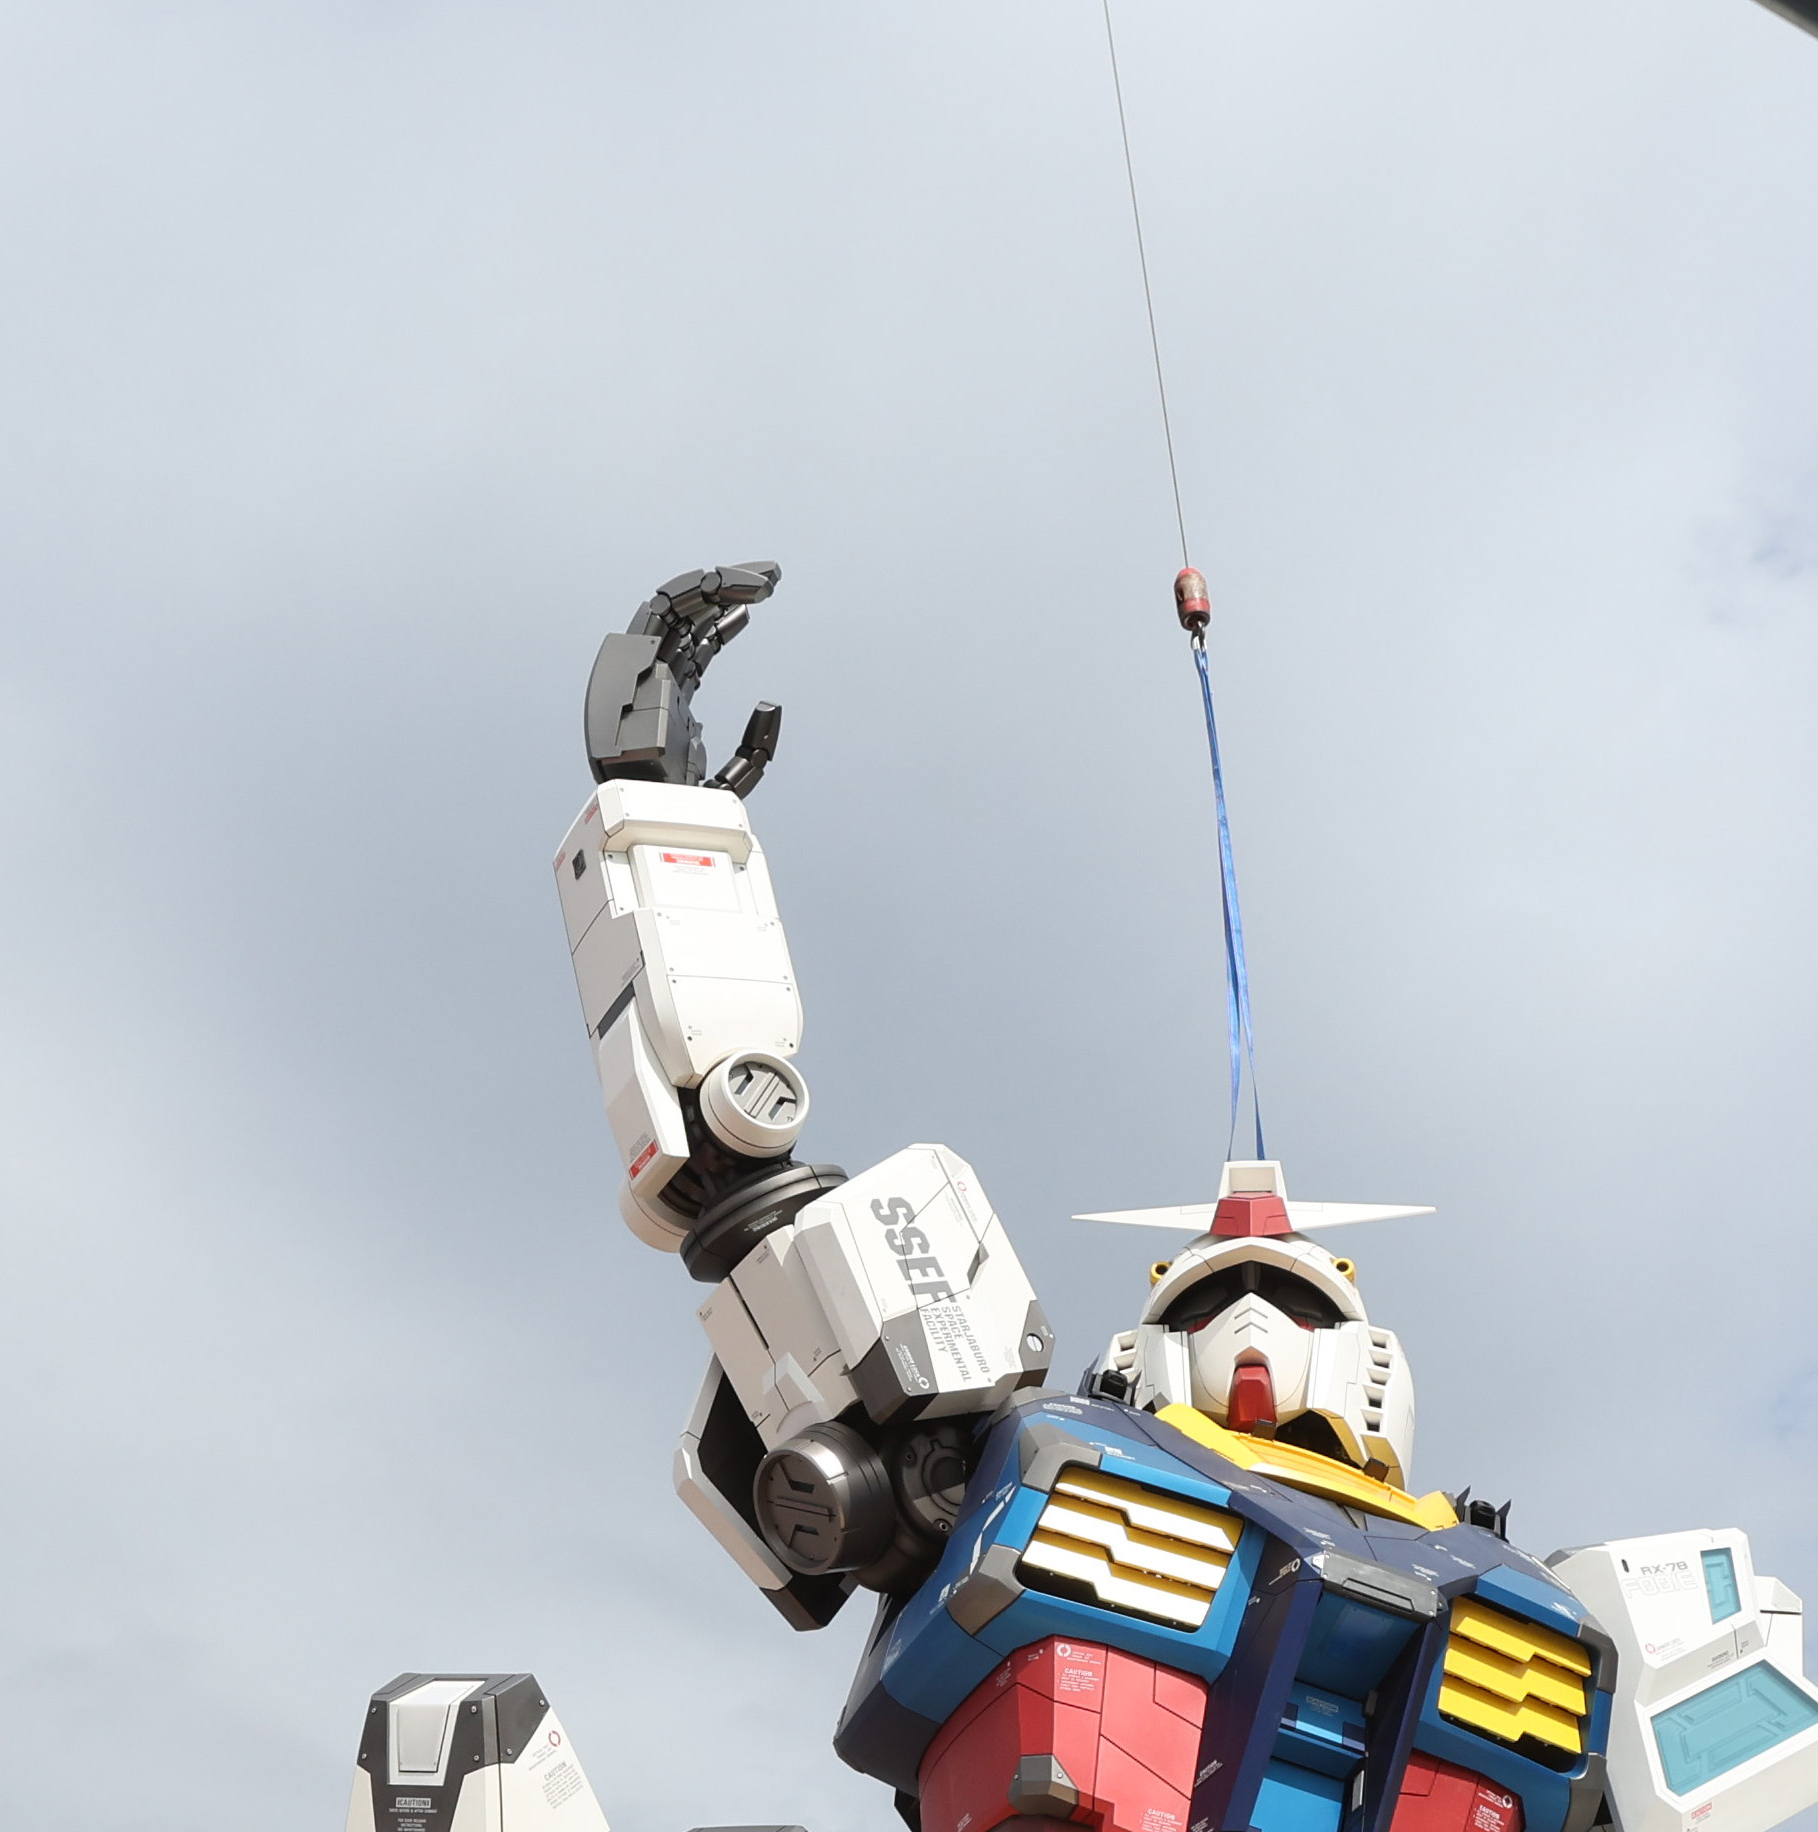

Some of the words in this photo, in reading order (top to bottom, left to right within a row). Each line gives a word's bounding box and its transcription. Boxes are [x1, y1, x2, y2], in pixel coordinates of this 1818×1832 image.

[870, 1197, 957, 1303] SSEF
[920, 1308, 948, 1352] FACILITY
[931, 1307, 972, 1383] EXPERIMENTAL
[941, 1306, 963, 1340] SPACE
[951, 1305, 991, 1374] STARJABURO
[1640, 1561, 1688, 1575] RX-78
